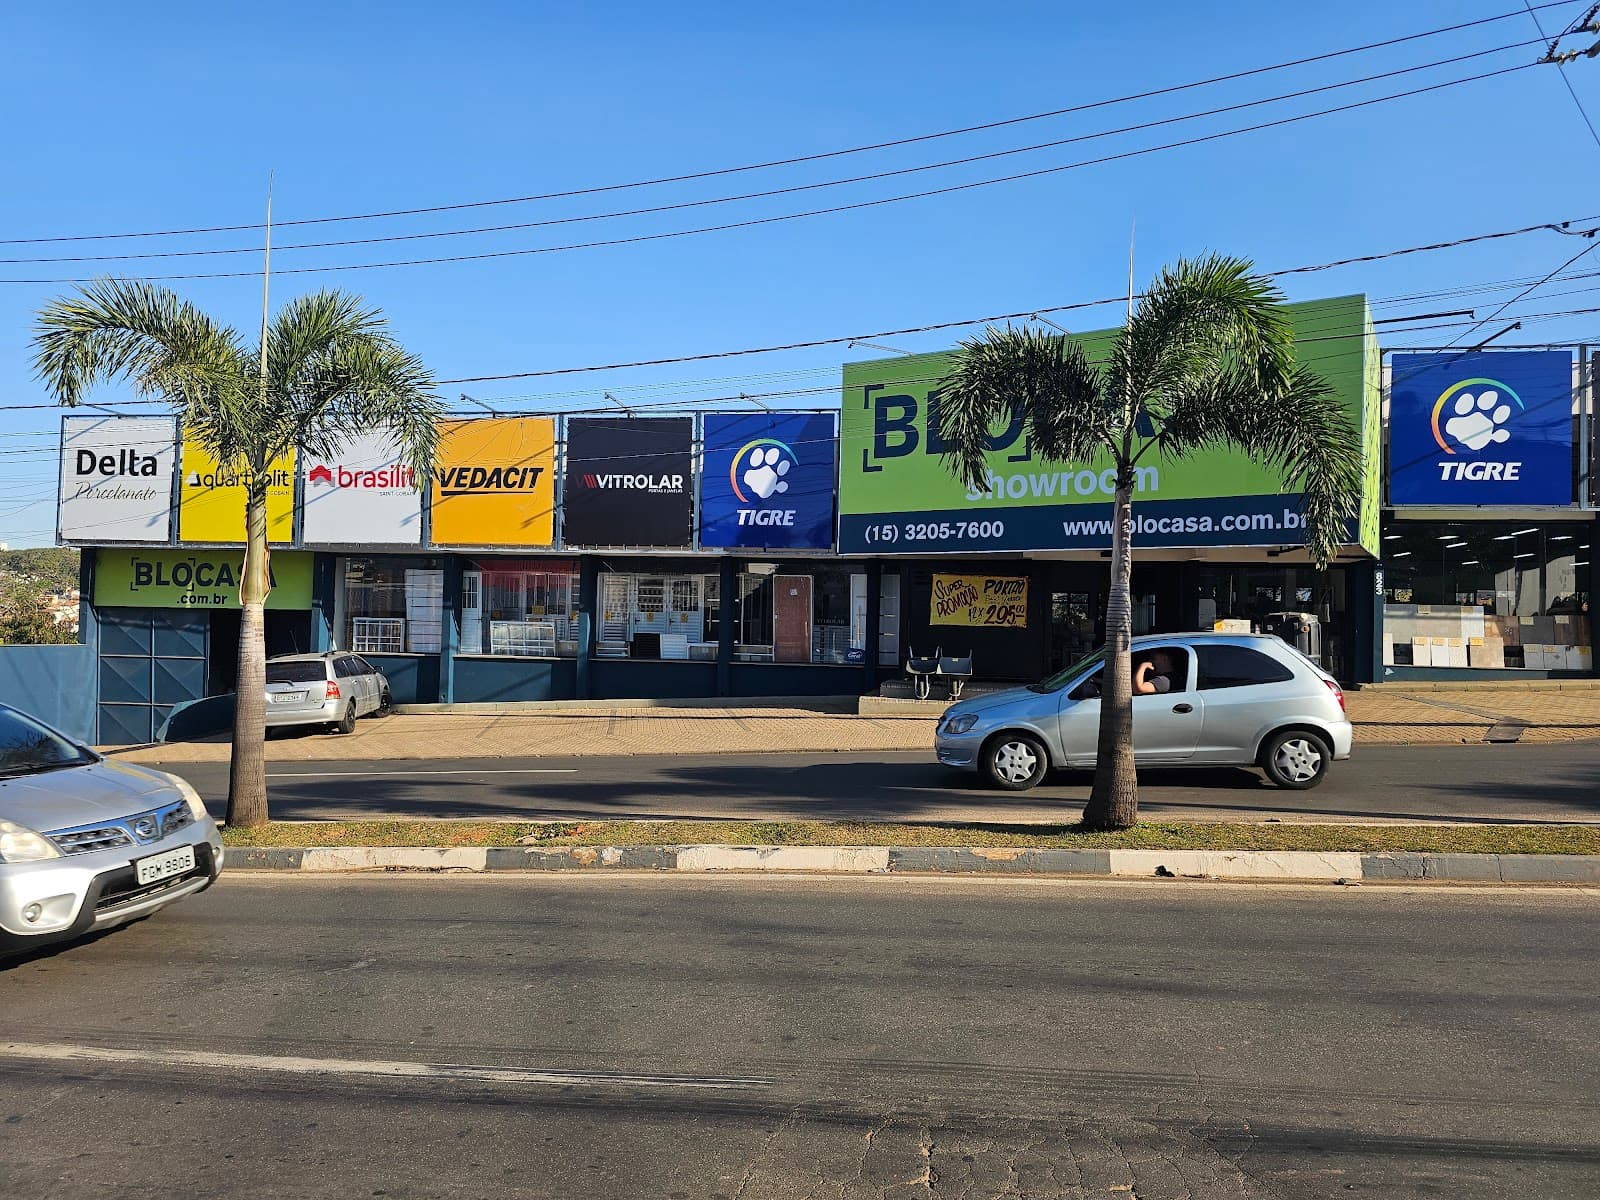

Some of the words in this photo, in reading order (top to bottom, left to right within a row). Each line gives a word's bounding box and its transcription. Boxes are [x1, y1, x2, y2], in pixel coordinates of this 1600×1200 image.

[77, 449, 157, 476] Delta
[1438, 461, 1522, 481] TIGRE
[203, 469, 289, 490] quartolit
[338, 465, 415, 488] brasilit
[440, 467, 544, 488] VEDACIT
[596, 474, 683, 489] VITROLAR
[76, 481, 157, 500] Porcelanato
[736, 509, 797, 526] TIGRE
[1063, 508, 1307, 537] wwwblocasa.com.br
[865, 524, 899, 544] (15)
[905, 520, 1004, 541] 3205-7600
[135, 562, 277, 588] BLOCA
[176, 593, 228, 604] .com.br
